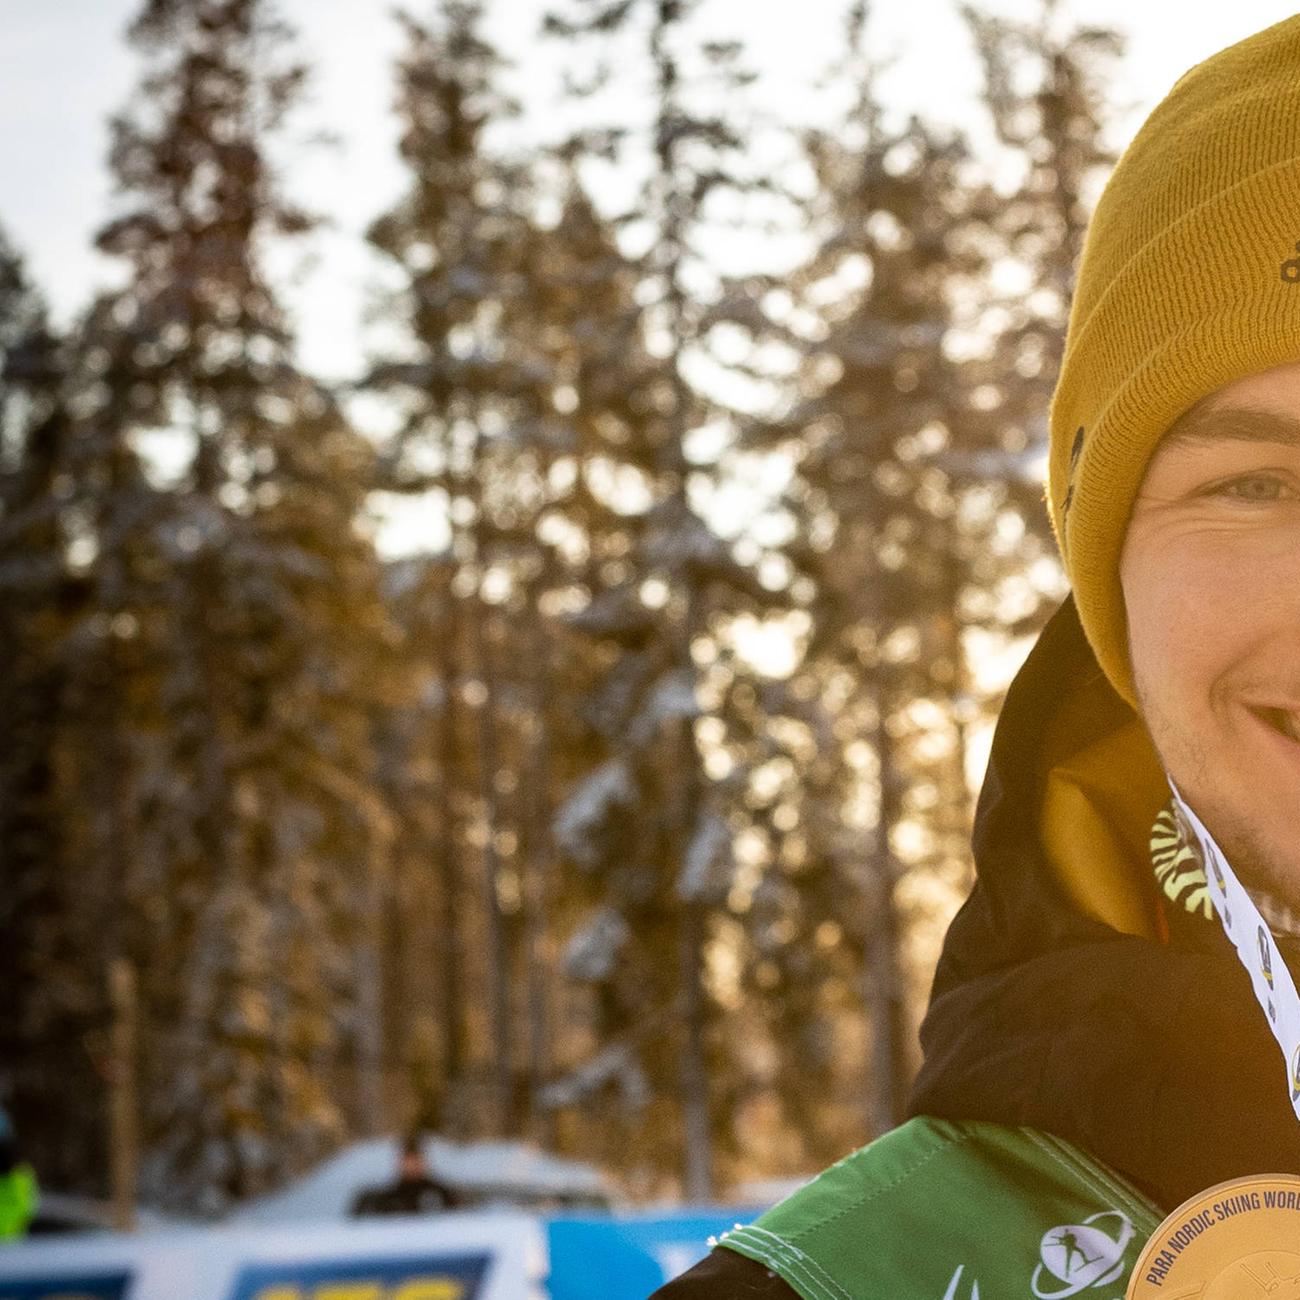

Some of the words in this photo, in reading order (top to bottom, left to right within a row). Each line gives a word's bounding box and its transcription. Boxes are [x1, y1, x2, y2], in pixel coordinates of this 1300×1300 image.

[1146, 1249, 1177, 1287] PARA
[1167, 1209, 1216, 1254] NORDIC
[1213, 1192, 1261, 1221] SKIING
